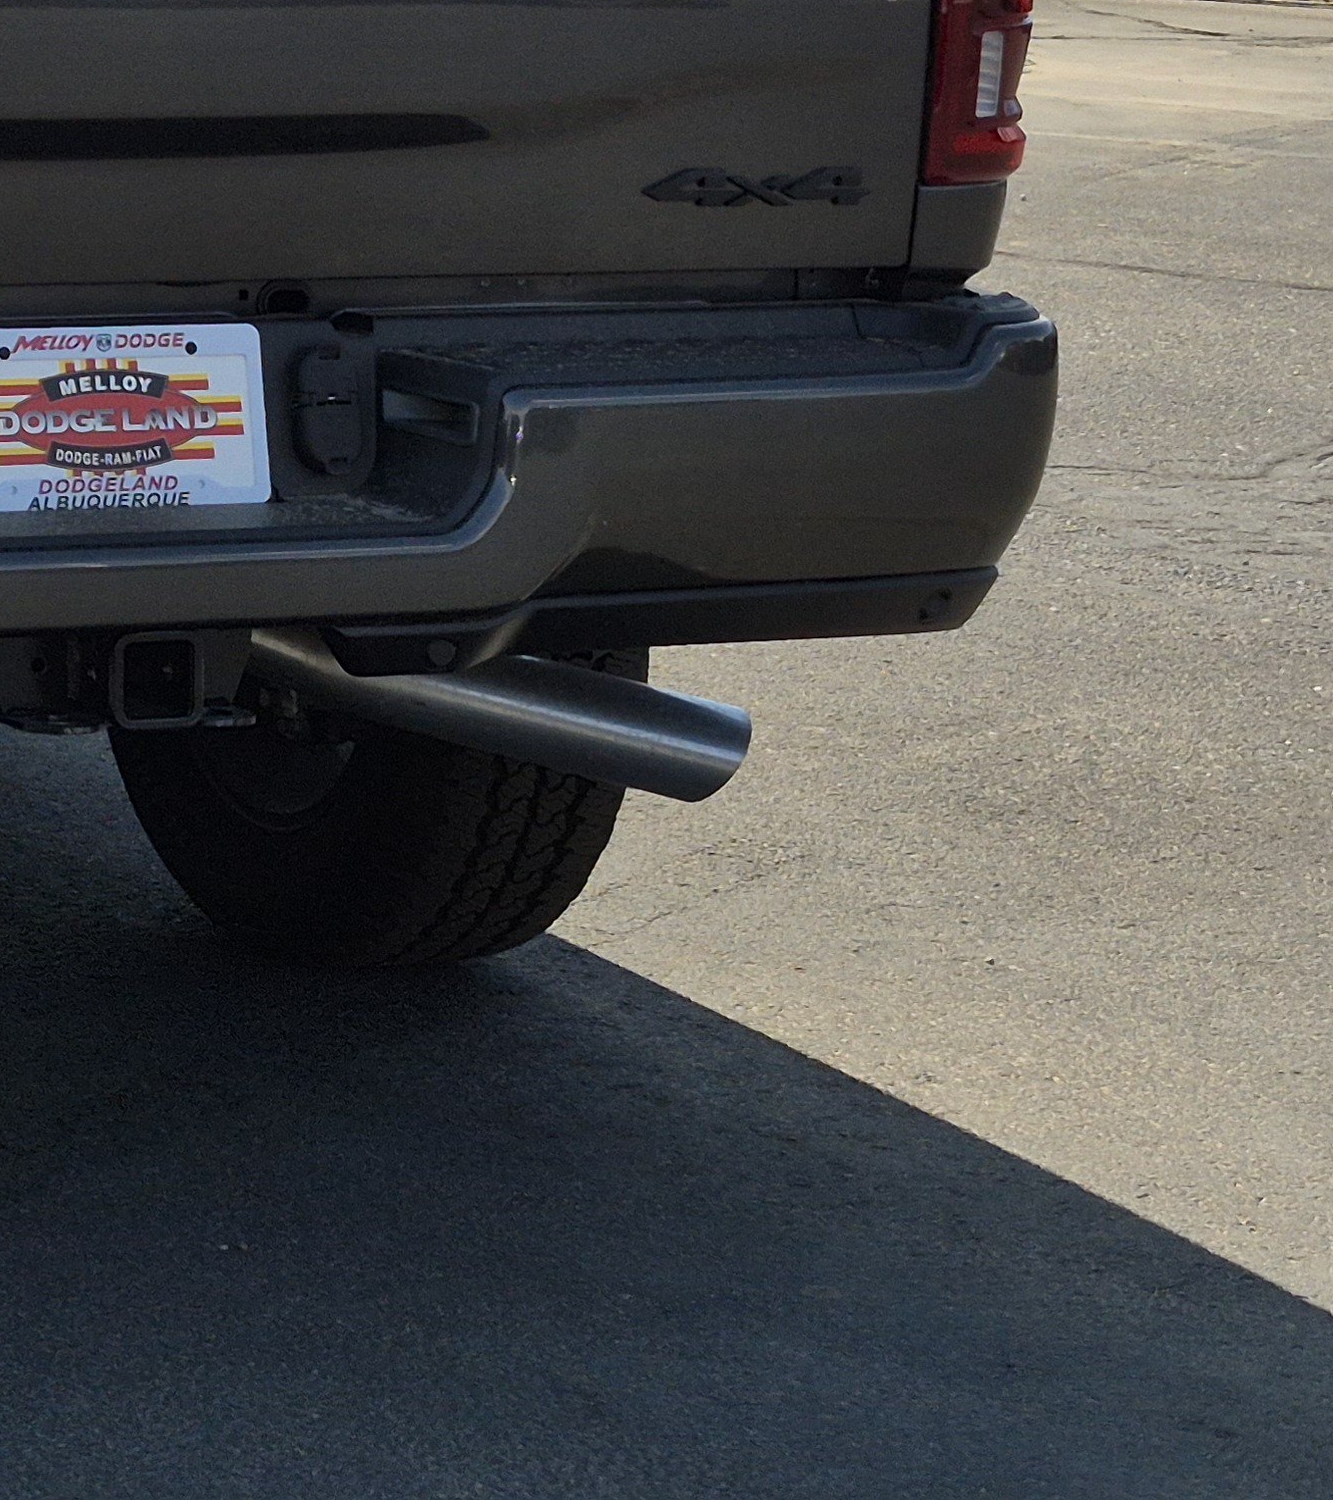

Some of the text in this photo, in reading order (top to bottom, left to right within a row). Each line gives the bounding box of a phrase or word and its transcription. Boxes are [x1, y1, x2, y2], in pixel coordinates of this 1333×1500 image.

[11, 331, 186, 353] MELLOY DODGE
[58, 374, 152, 396] MELLOY
[38, 474, 180, 495] DODGELAND
[27, 490, 192, 513] ALBUQUERQUE
